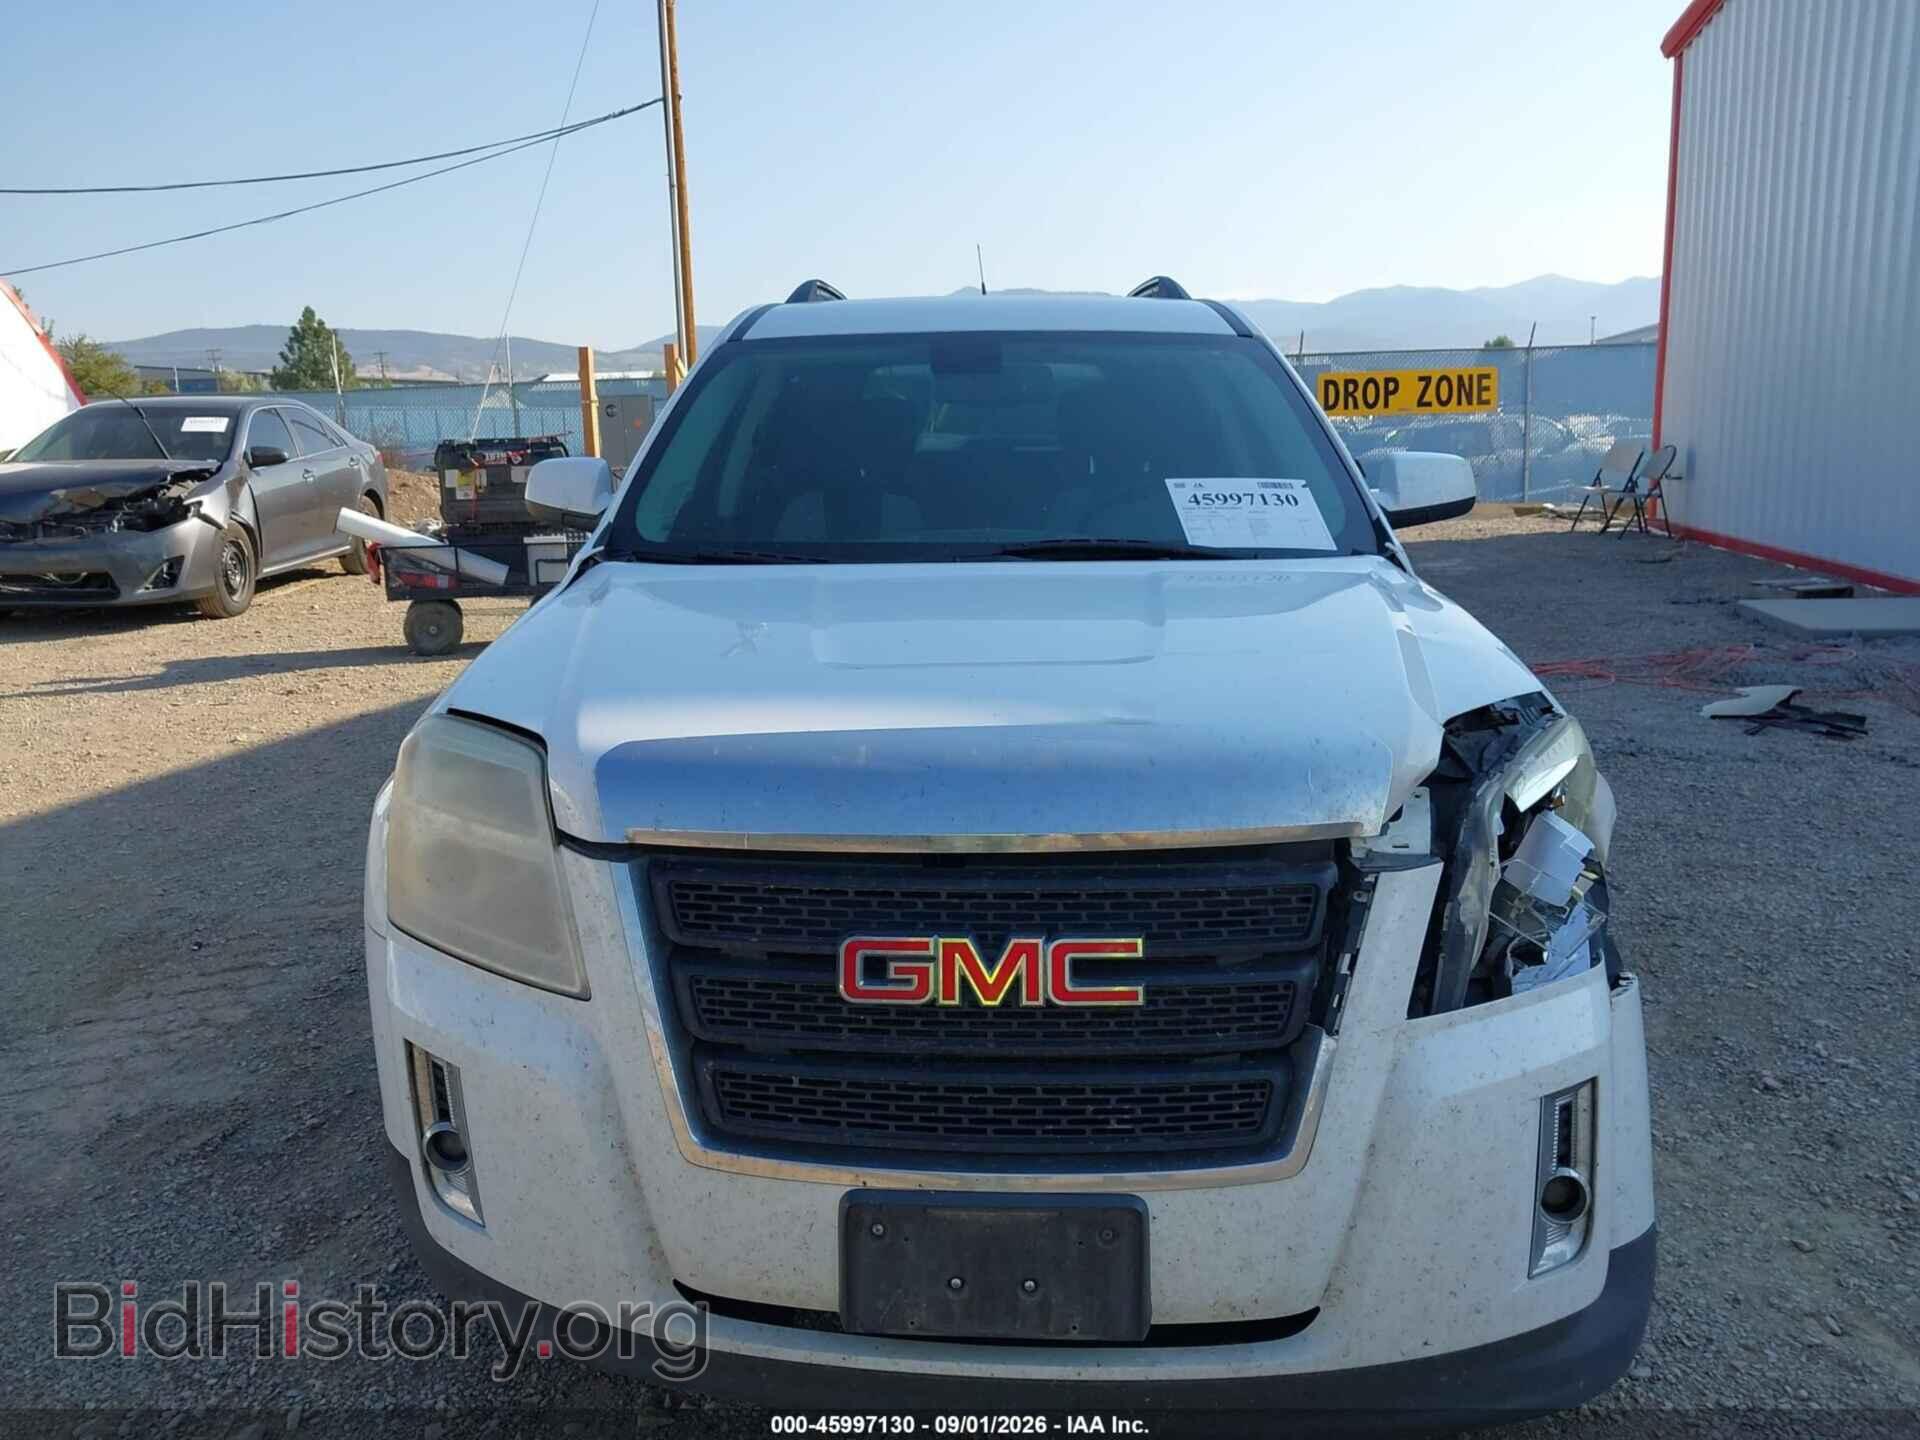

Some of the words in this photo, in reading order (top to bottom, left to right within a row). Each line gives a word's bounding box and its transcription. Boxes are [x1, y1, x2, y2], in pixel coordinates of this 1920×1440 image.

[1323, 376, 1400, 411] DROP
[1416, 373, 1492, 408] ZONE
[1187, 492, 1299, 507] 45997130
[839, 936, 1144, 1006] GMC
